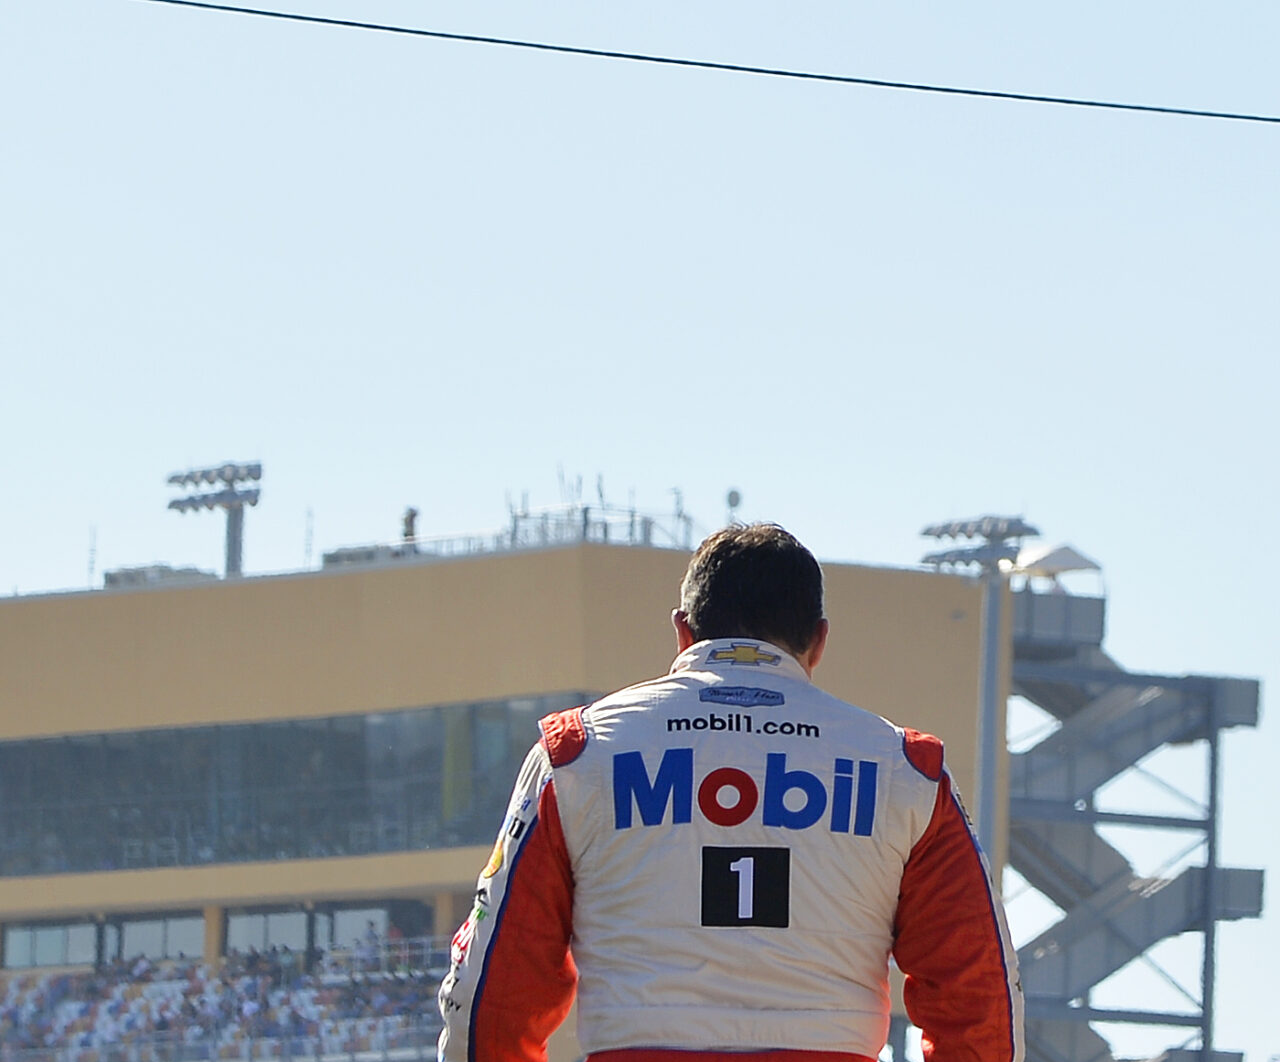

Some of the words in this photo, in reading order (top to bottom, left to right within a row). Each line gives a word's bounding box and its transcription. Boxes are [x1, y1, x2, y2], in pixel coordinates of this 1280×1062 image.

[667, 713, 820, 738] mobil1.com
[613, 747, 878, 837] Mobil
[729, 856, 755, 919] 1
